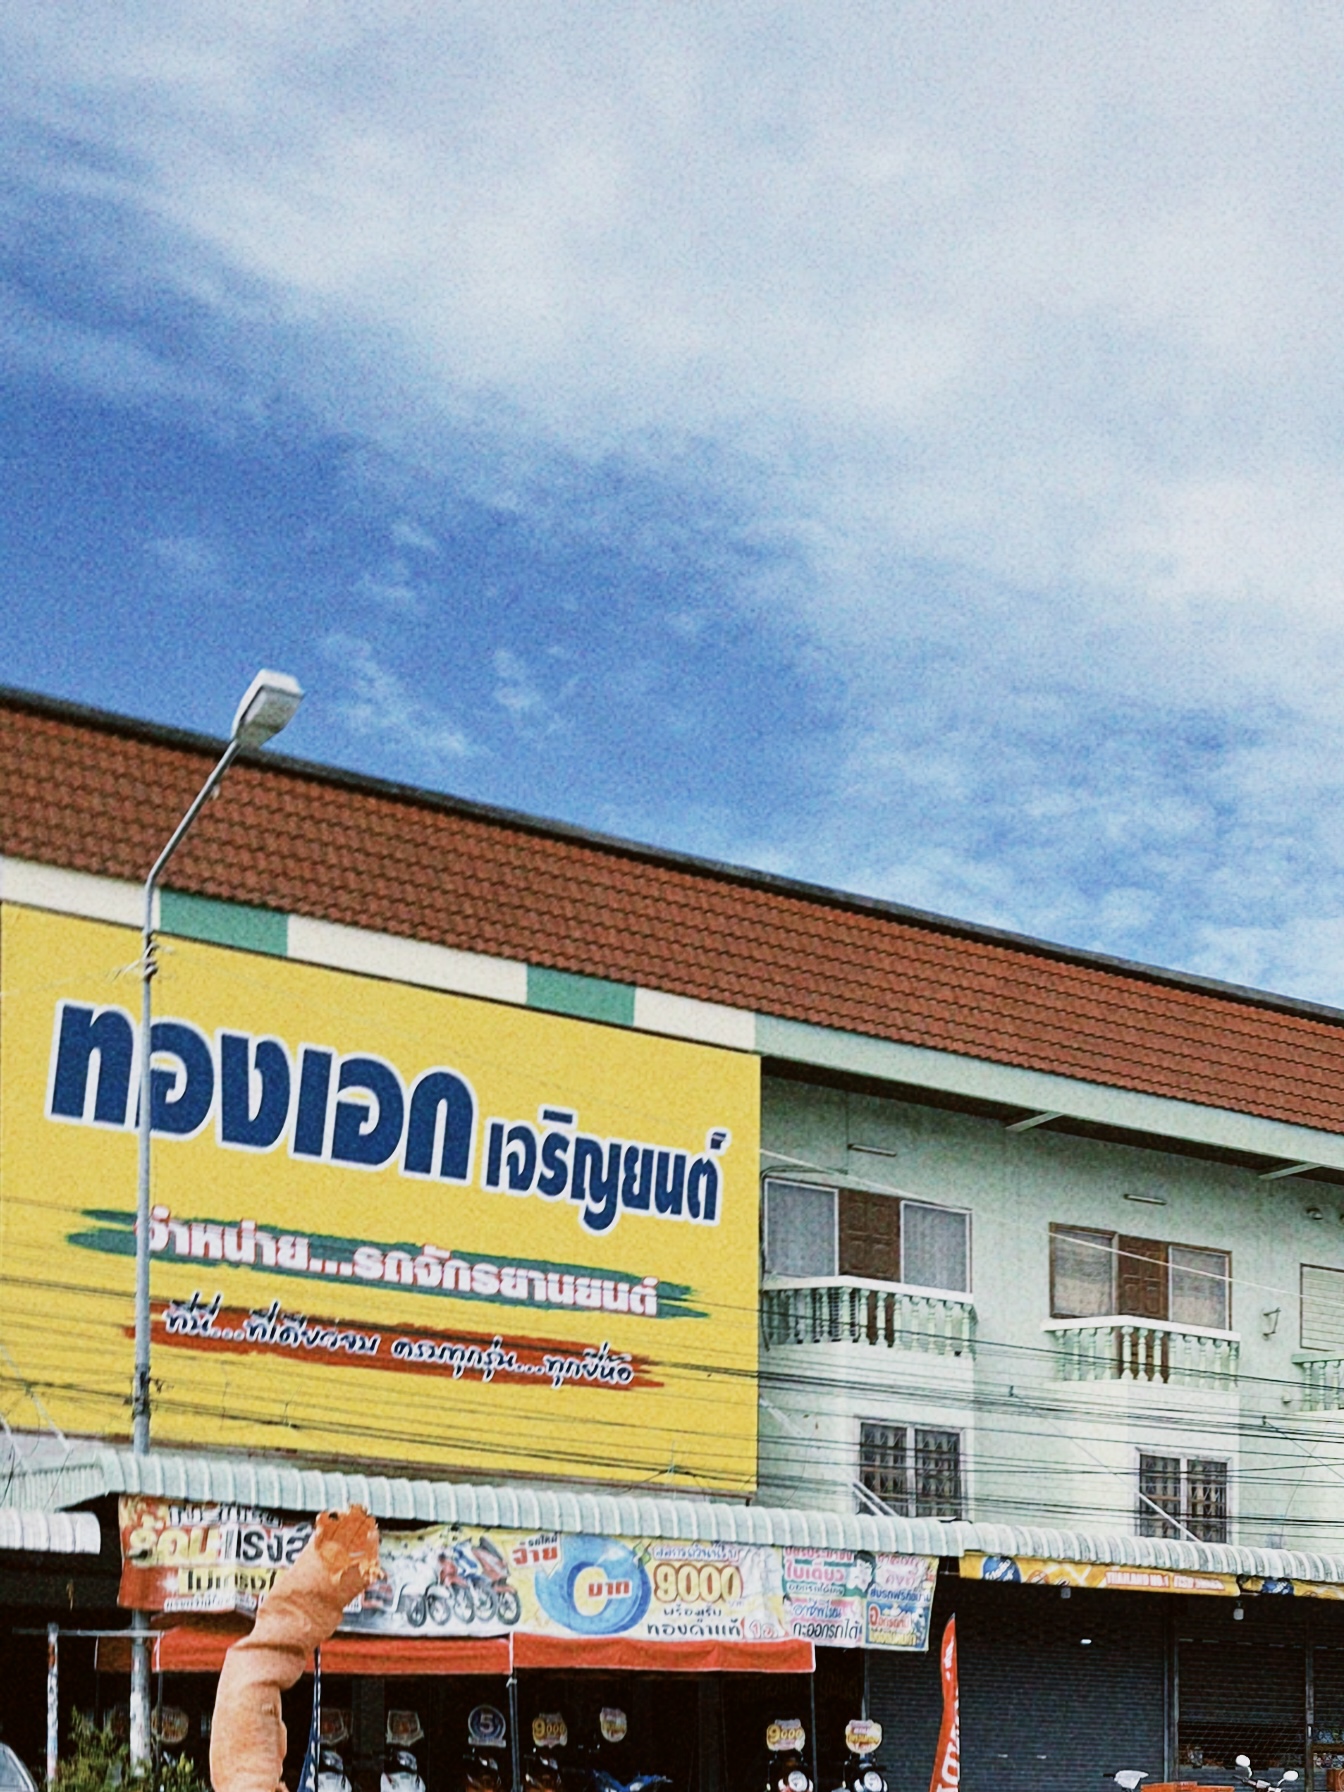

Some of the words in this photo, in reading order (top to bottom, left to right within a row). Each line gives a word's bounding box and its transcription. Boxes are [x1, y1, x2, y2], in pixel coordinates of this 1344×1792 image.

[51, 1004, 473, 1180] ทองเอก
[486, 1109, 726, 1231] เจริญยนต์
[588, 1580, 630, 1597] บาท
[654, 1563, 743, 1603] 9000
